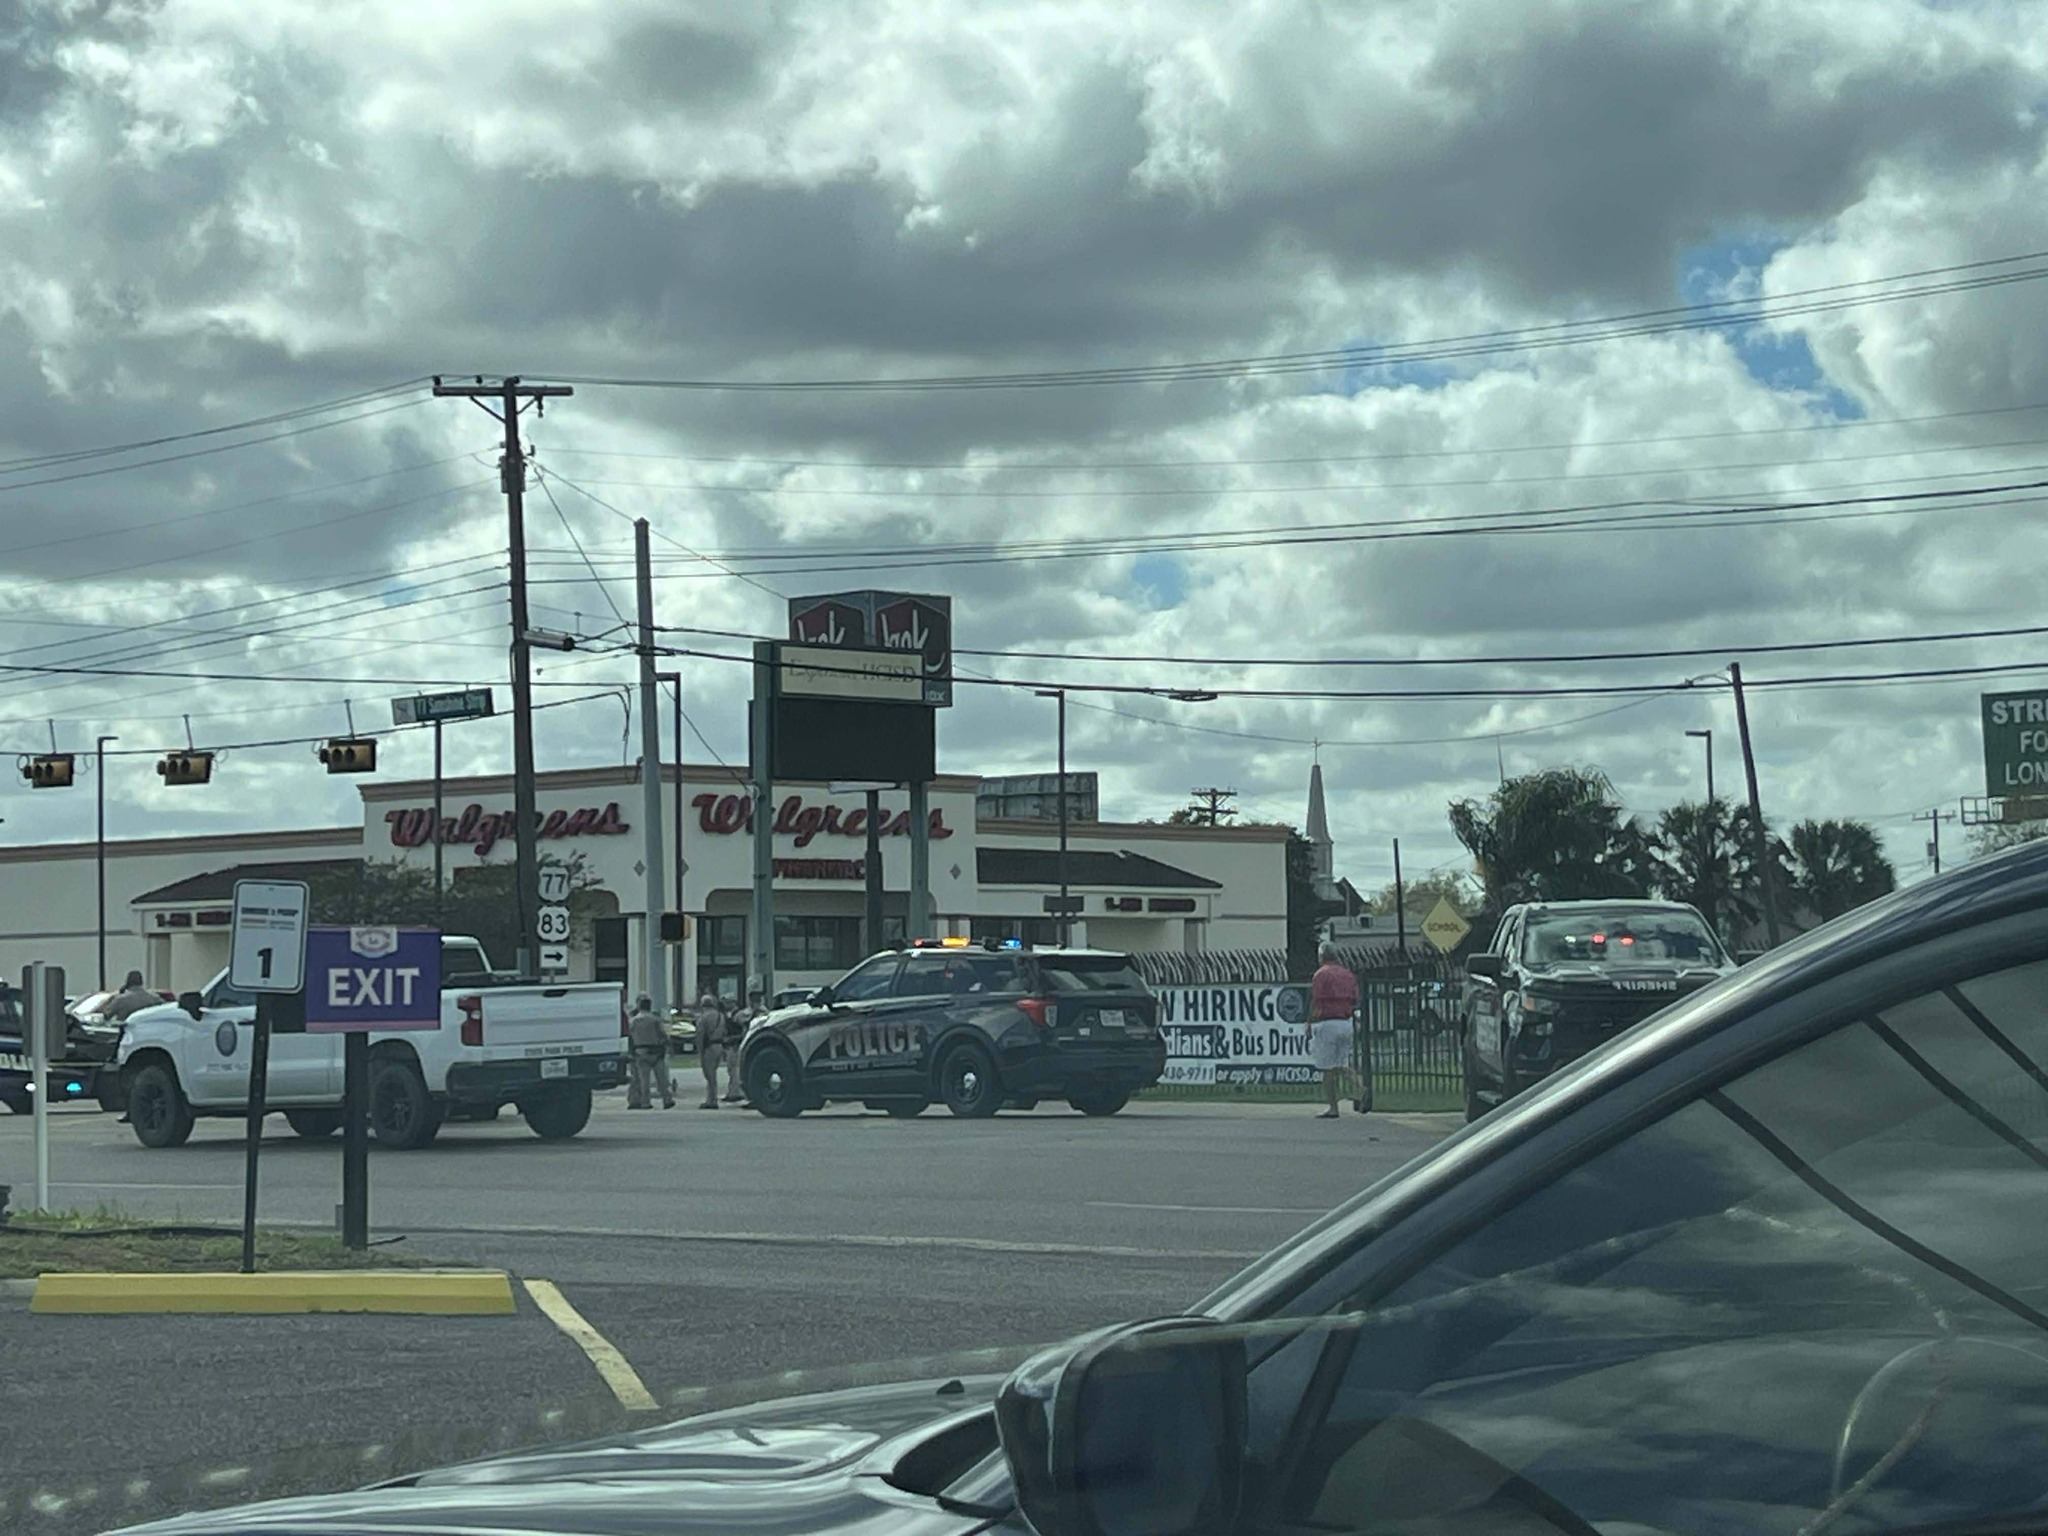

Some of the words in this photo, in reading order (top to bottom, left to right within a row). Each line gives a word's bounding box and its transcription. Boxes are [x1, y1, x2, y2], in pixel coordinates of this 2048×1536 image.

[1991, 699, 2048, 725] STR
[543, 874, 567, 894] 77
[541, 914, 567, 934] 83
[257, 947, 274, 979] 1
[327, 966, 421, 1006] EXIT
[1183, 988, 1275, 1022] HIRING
[828, 1022, 922, 1060] POLICE
[1214, 1025, 1230, 1058] &
[1232, 1028, 1264, 1056] Bus
[1229, 1067, 1262, 1084] apply
